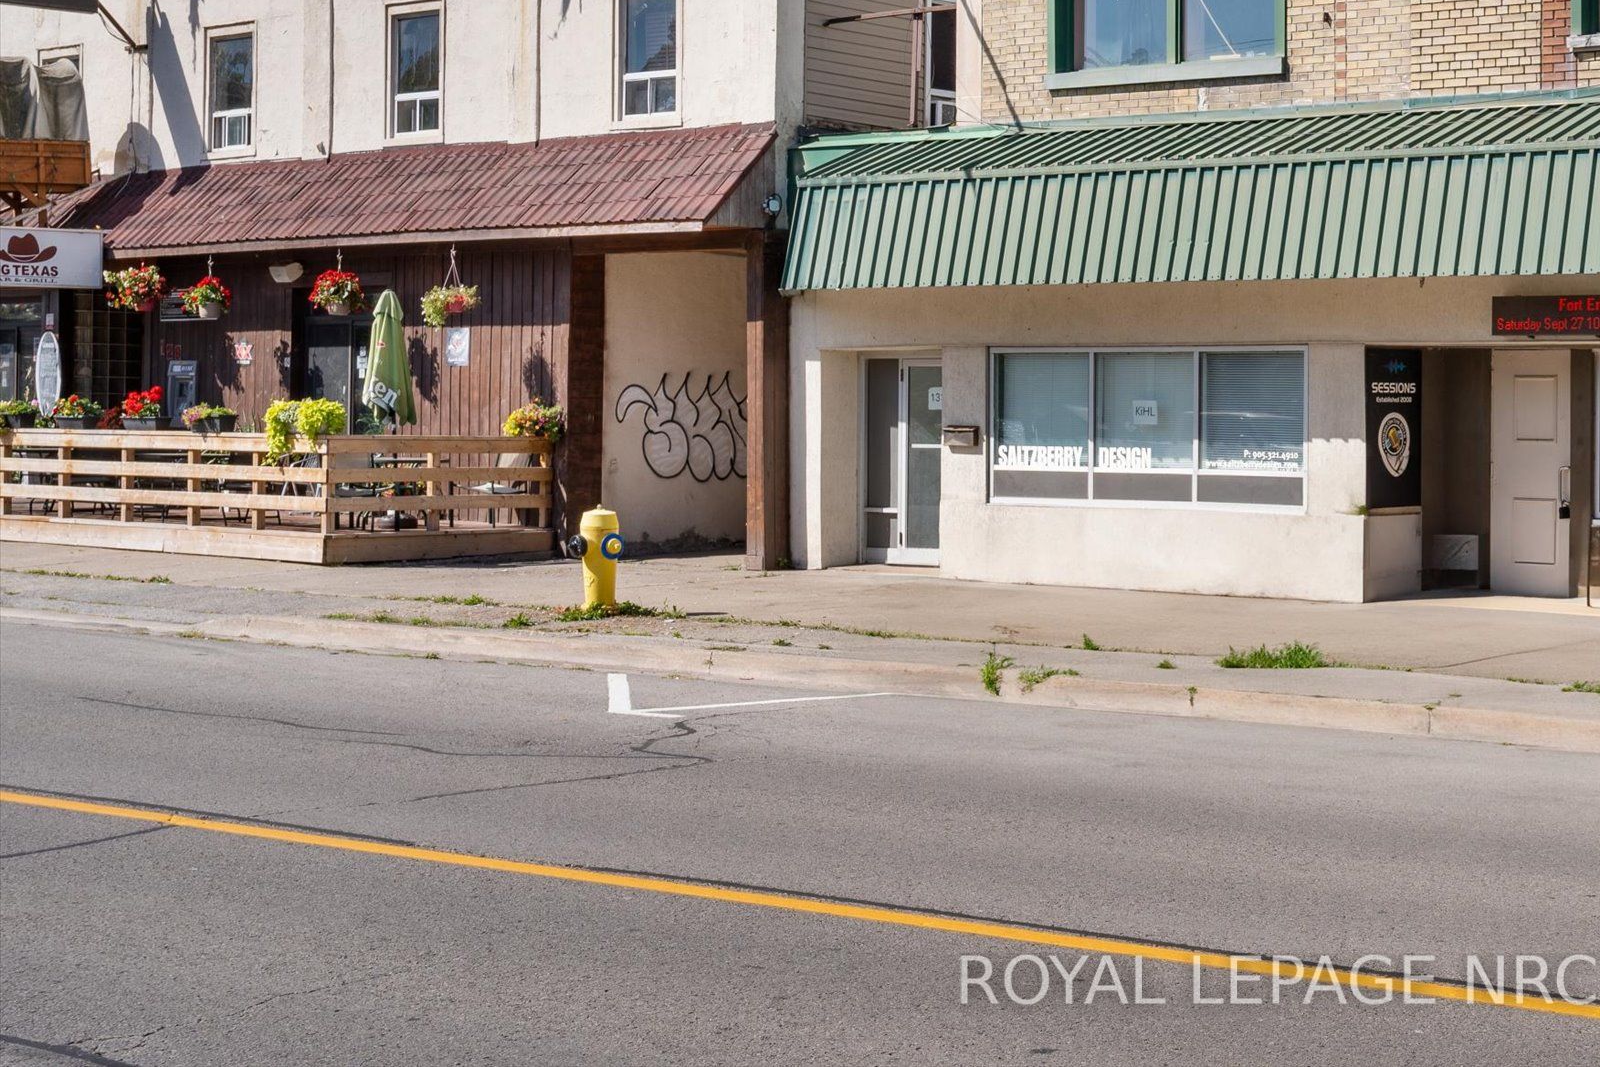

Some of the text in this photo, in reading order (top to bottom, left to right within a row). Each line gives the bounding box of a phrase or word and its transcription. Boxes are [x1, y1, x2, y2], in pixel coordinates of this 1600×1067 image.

[12, 264, 59, 277] TEXAS
[1558, 298, 1583, 312] Fort
[1497, 318, 1541, 331] Saturday
[1544, 317, 1569, 331] Sept
[1570, 317, 1584, 330] 27
[1371, 382, 1417, 394] SESSIONS
[998, 445, 1152, 469] SALTZBERRY DESIGN
[1252, 451, 1299, 460] 905.321.4910
